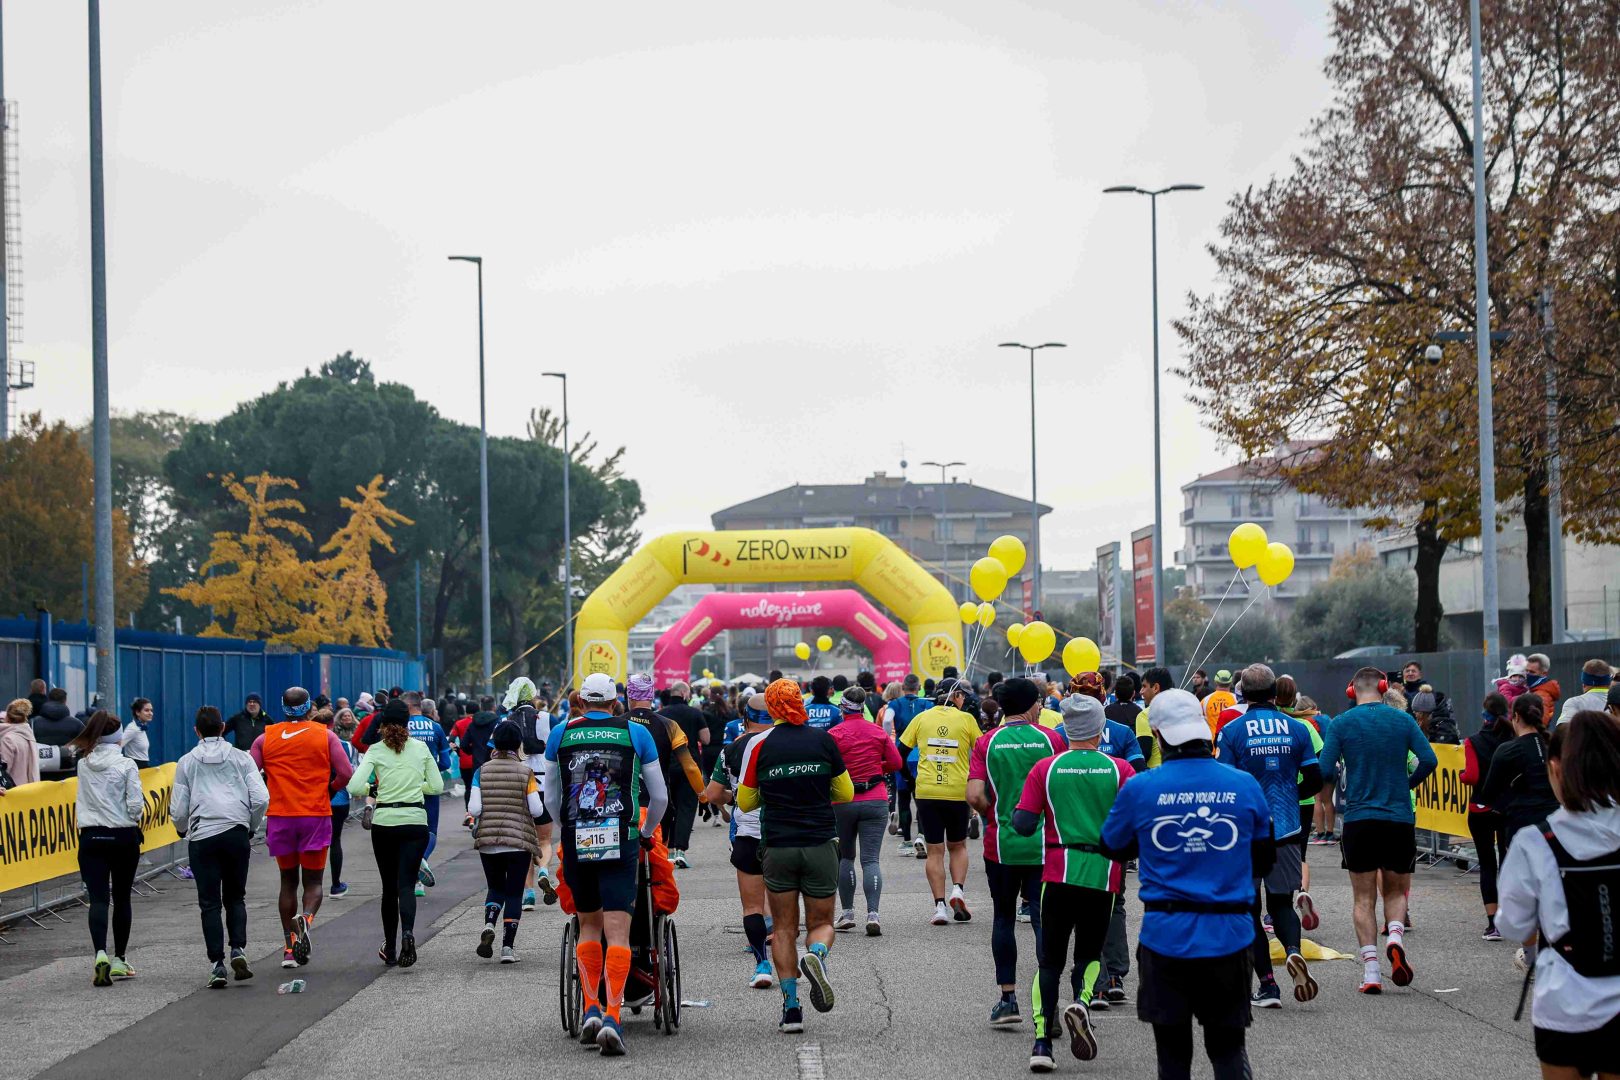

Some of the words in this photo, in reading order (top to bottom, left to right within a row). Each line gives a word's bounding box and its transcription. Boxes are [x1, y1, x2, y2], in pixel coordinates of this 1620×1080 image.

[736, 539, 790, 561] ZERO
[791, 545, 848, 560] WIND
[740, 599, 822, 622] noleggiare
[930, 656, 951, 666] ZERO
[589, 663, 610, 673] ZERO
[809, 709, 831, 718] RUN
[408, 720, 433, 731] RUN
[630, 716, 651, 724] KRISTAL
[1245, 718, 1290, 737] RUN
[570, 731, 586, 741] KM
[587, 731, 622, 741] SPORT
[1249, 738, 1266, 746] DON'T
[1250, 746, 1280, 756] FINISH
[1281, 745, 1291, 754] IT!
[568, 753, 590, 771] Ciao
[769, 768, 784, 778] KM
[788, 764, 821, 776] SPORT
[1157, 792, 1177, 806] RUN
[1176, 792, 1195, 805] FOR
[1195, 792, 1217, 804] YOUR
[1216, 791, 1237, 804] LIFE
[29, 802, 79, 859] PADAN
